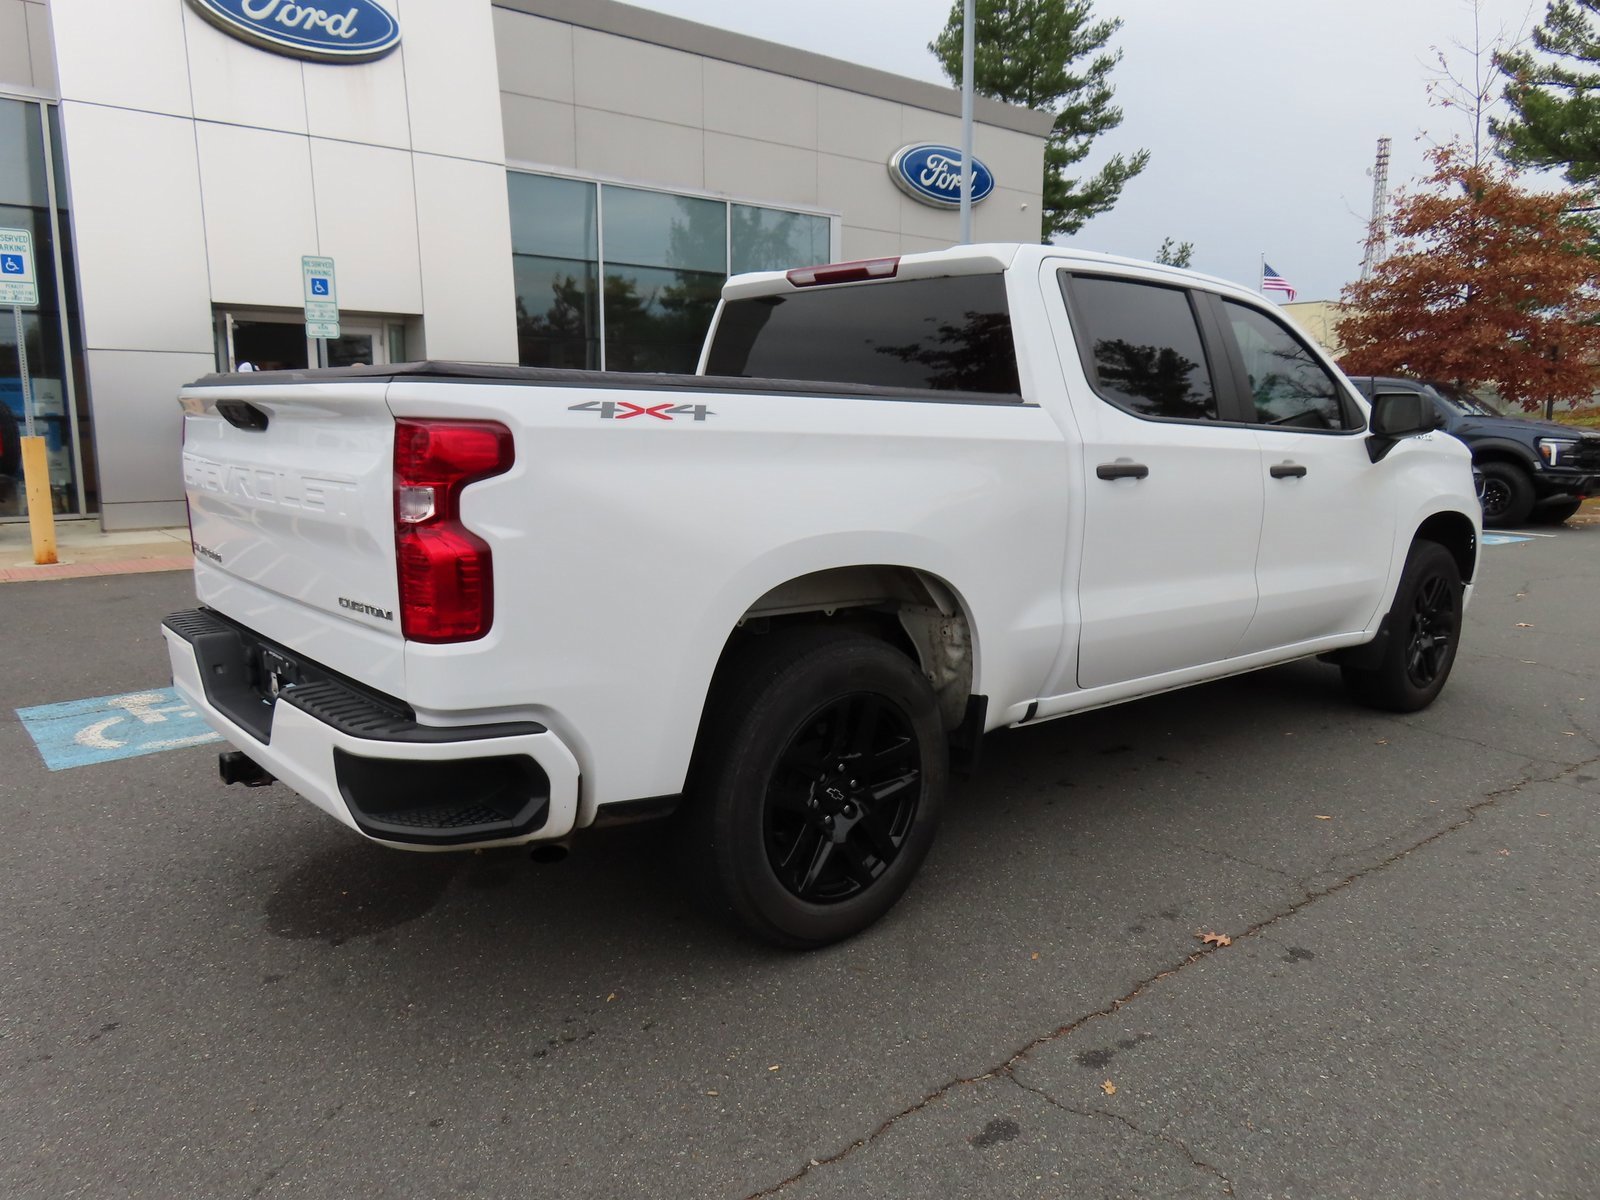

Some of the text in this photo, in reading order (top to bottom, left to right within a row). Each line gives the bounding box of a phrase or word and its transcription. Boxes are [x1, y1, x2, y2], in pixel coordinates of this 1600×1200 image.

[306, 268, 332, 277] PARKING
[568, 401, 717, 421] 4X4
[183, 455, 358, 516] CHEVROLET
[338, 597, 393, 622] CUSTOM
